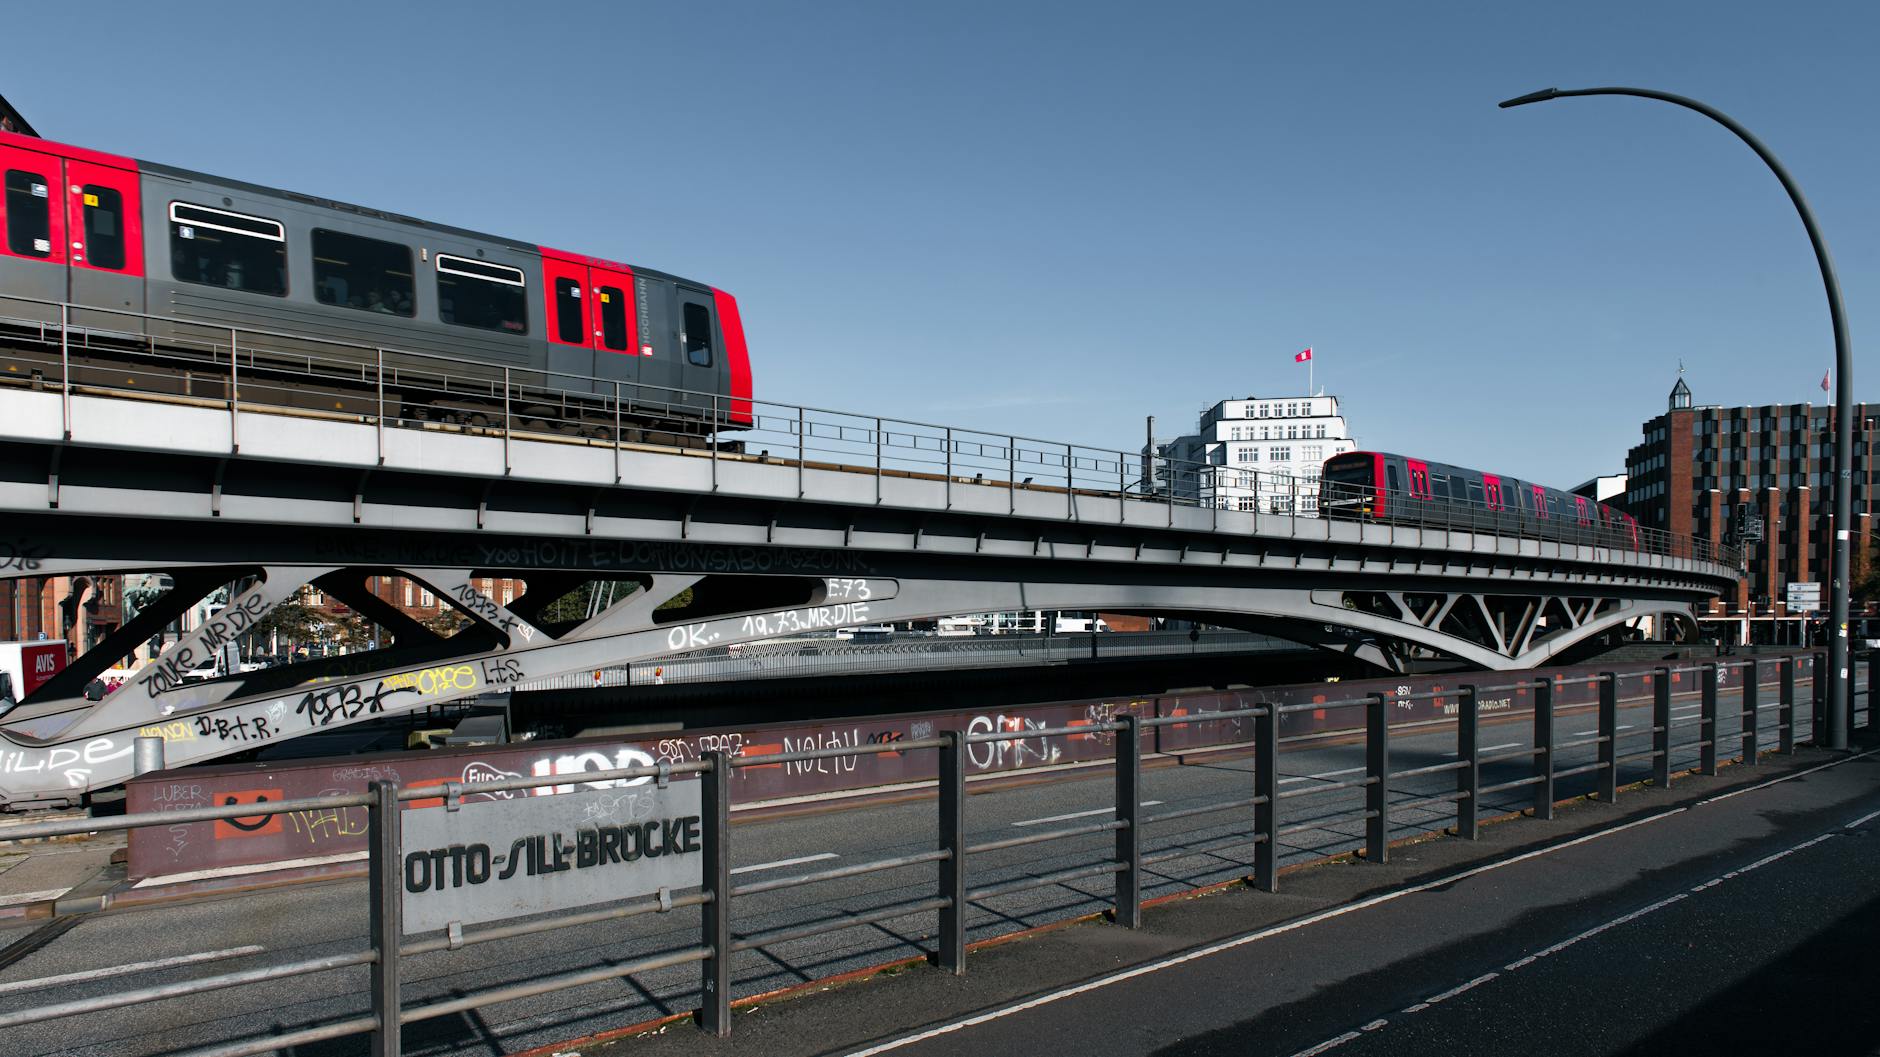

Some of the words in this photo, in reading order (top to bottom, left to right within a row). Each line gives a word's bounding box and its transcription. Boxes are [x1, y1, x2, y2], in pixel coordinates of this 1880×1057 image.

[640, 278, 650, 344] HOCHBAHN
[36, 654, 55, 673] AVIS
[405, 816, 701, 893] OTTO-SILL-BRÜCKE
